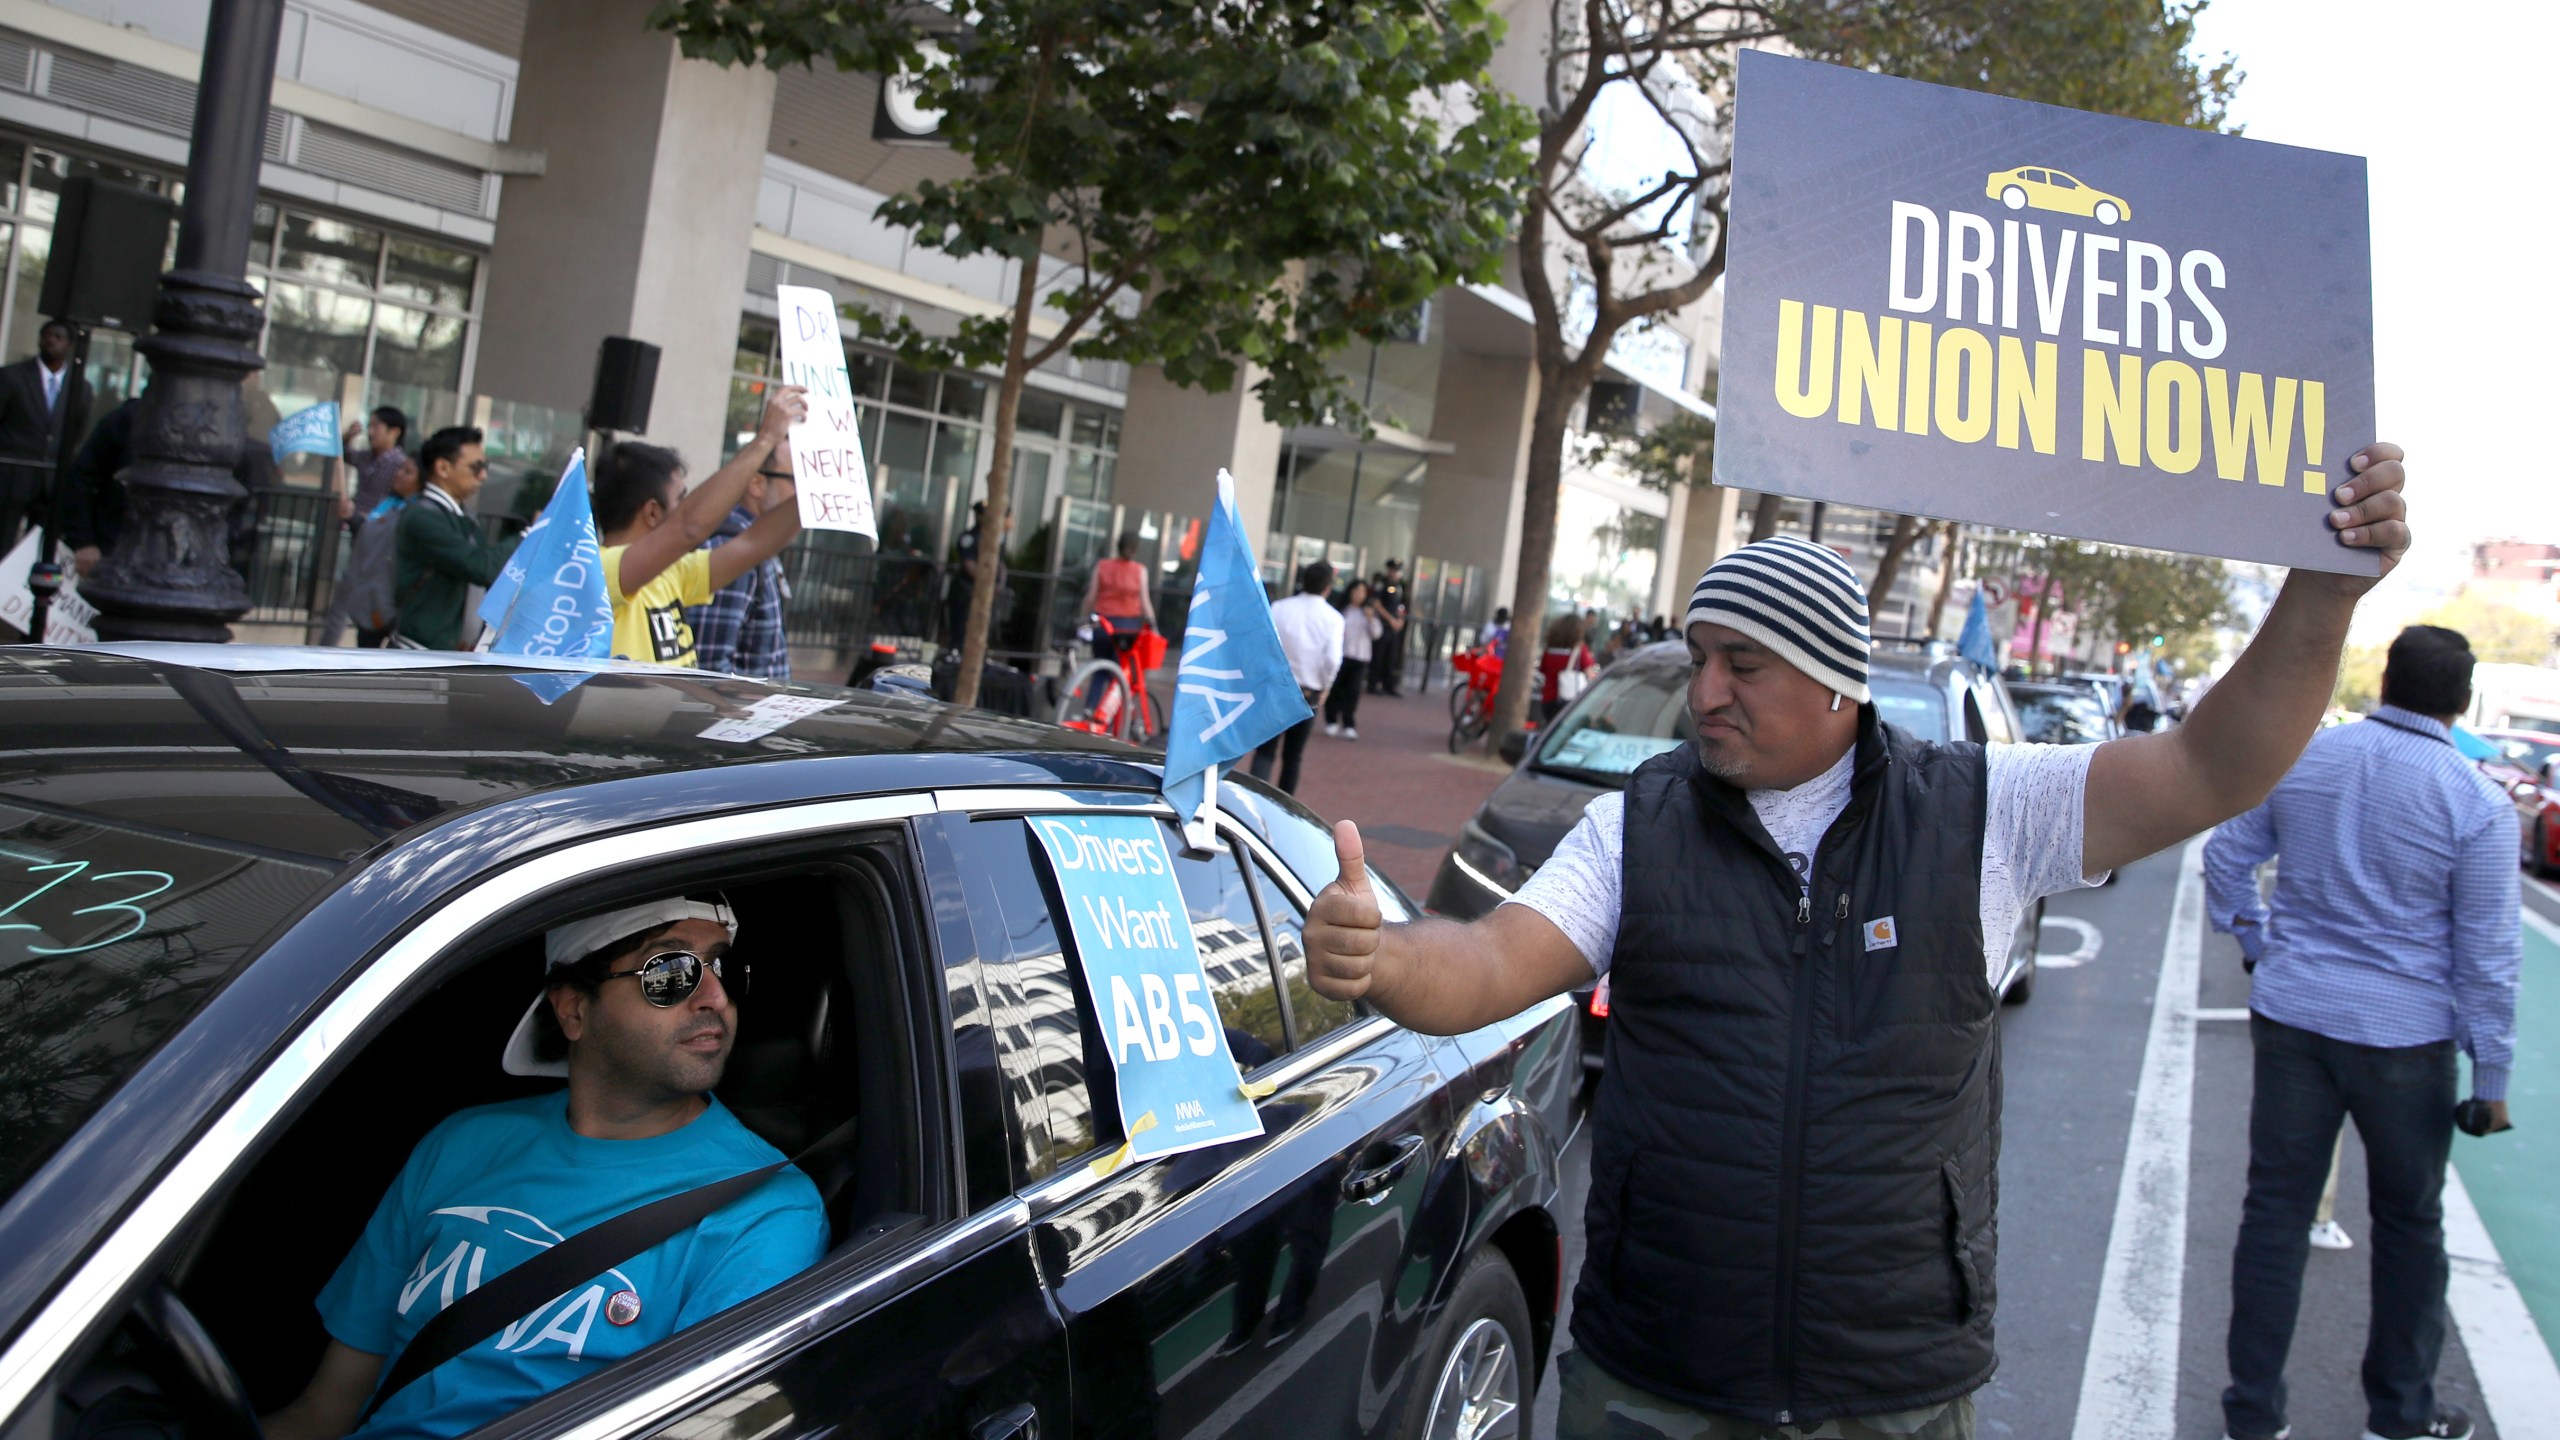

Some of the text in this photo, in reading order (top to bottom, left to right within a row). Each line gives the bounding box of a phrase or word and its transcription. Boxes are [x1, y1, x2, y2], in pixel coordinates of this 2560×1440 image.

[1888, 199, 2228, 360] DRIVERS
[1774, 298, 2327, 495] UNION NOW!
[523, 594, 582, 657] Stop
[1040, 819, 1164, 876] Drivers
[1082, 894, 1179, 950] Want
[1110, 972, 1217, 1065] AB5
